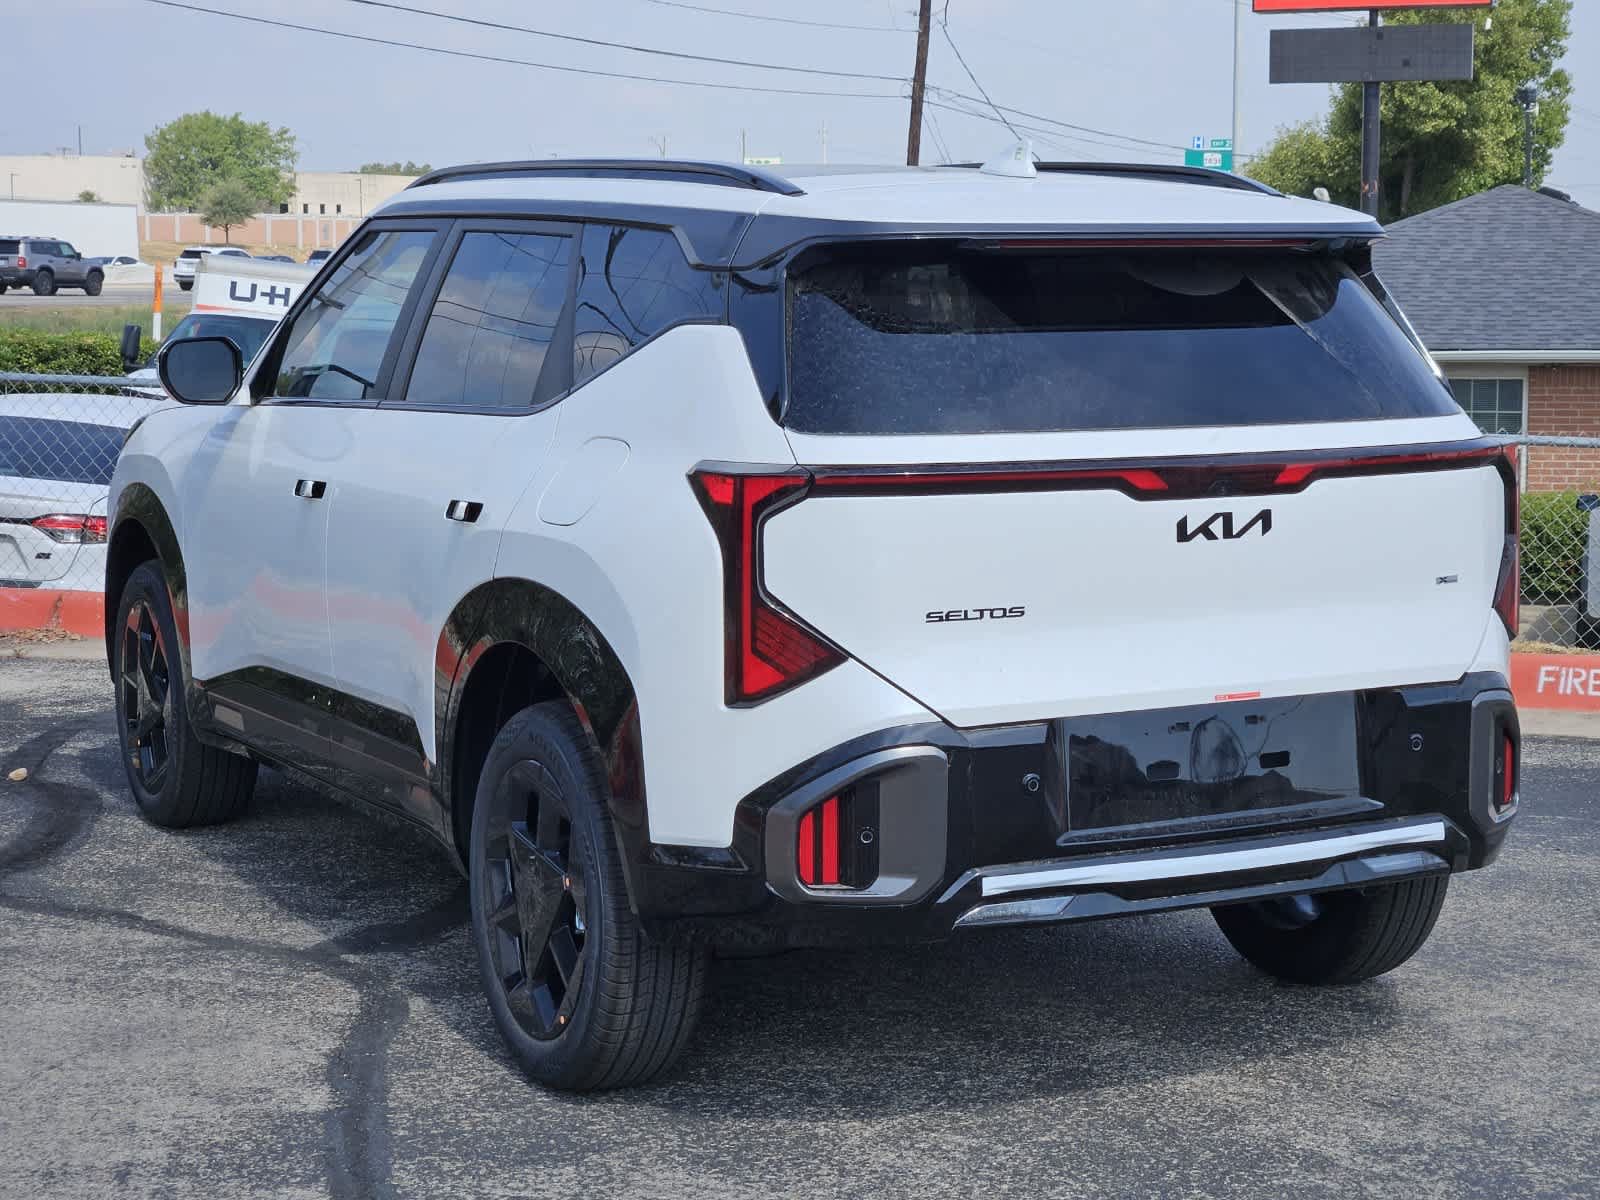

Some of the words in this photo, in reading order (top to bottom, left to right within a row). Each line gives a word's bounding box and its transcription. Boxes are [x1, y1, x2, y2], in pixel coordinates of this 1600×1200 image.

[1176, 508, 1272, 542] KIA
[926, 606, 1025, 623] SELTOS
[1536, 665, 1600, 697] FIRE
